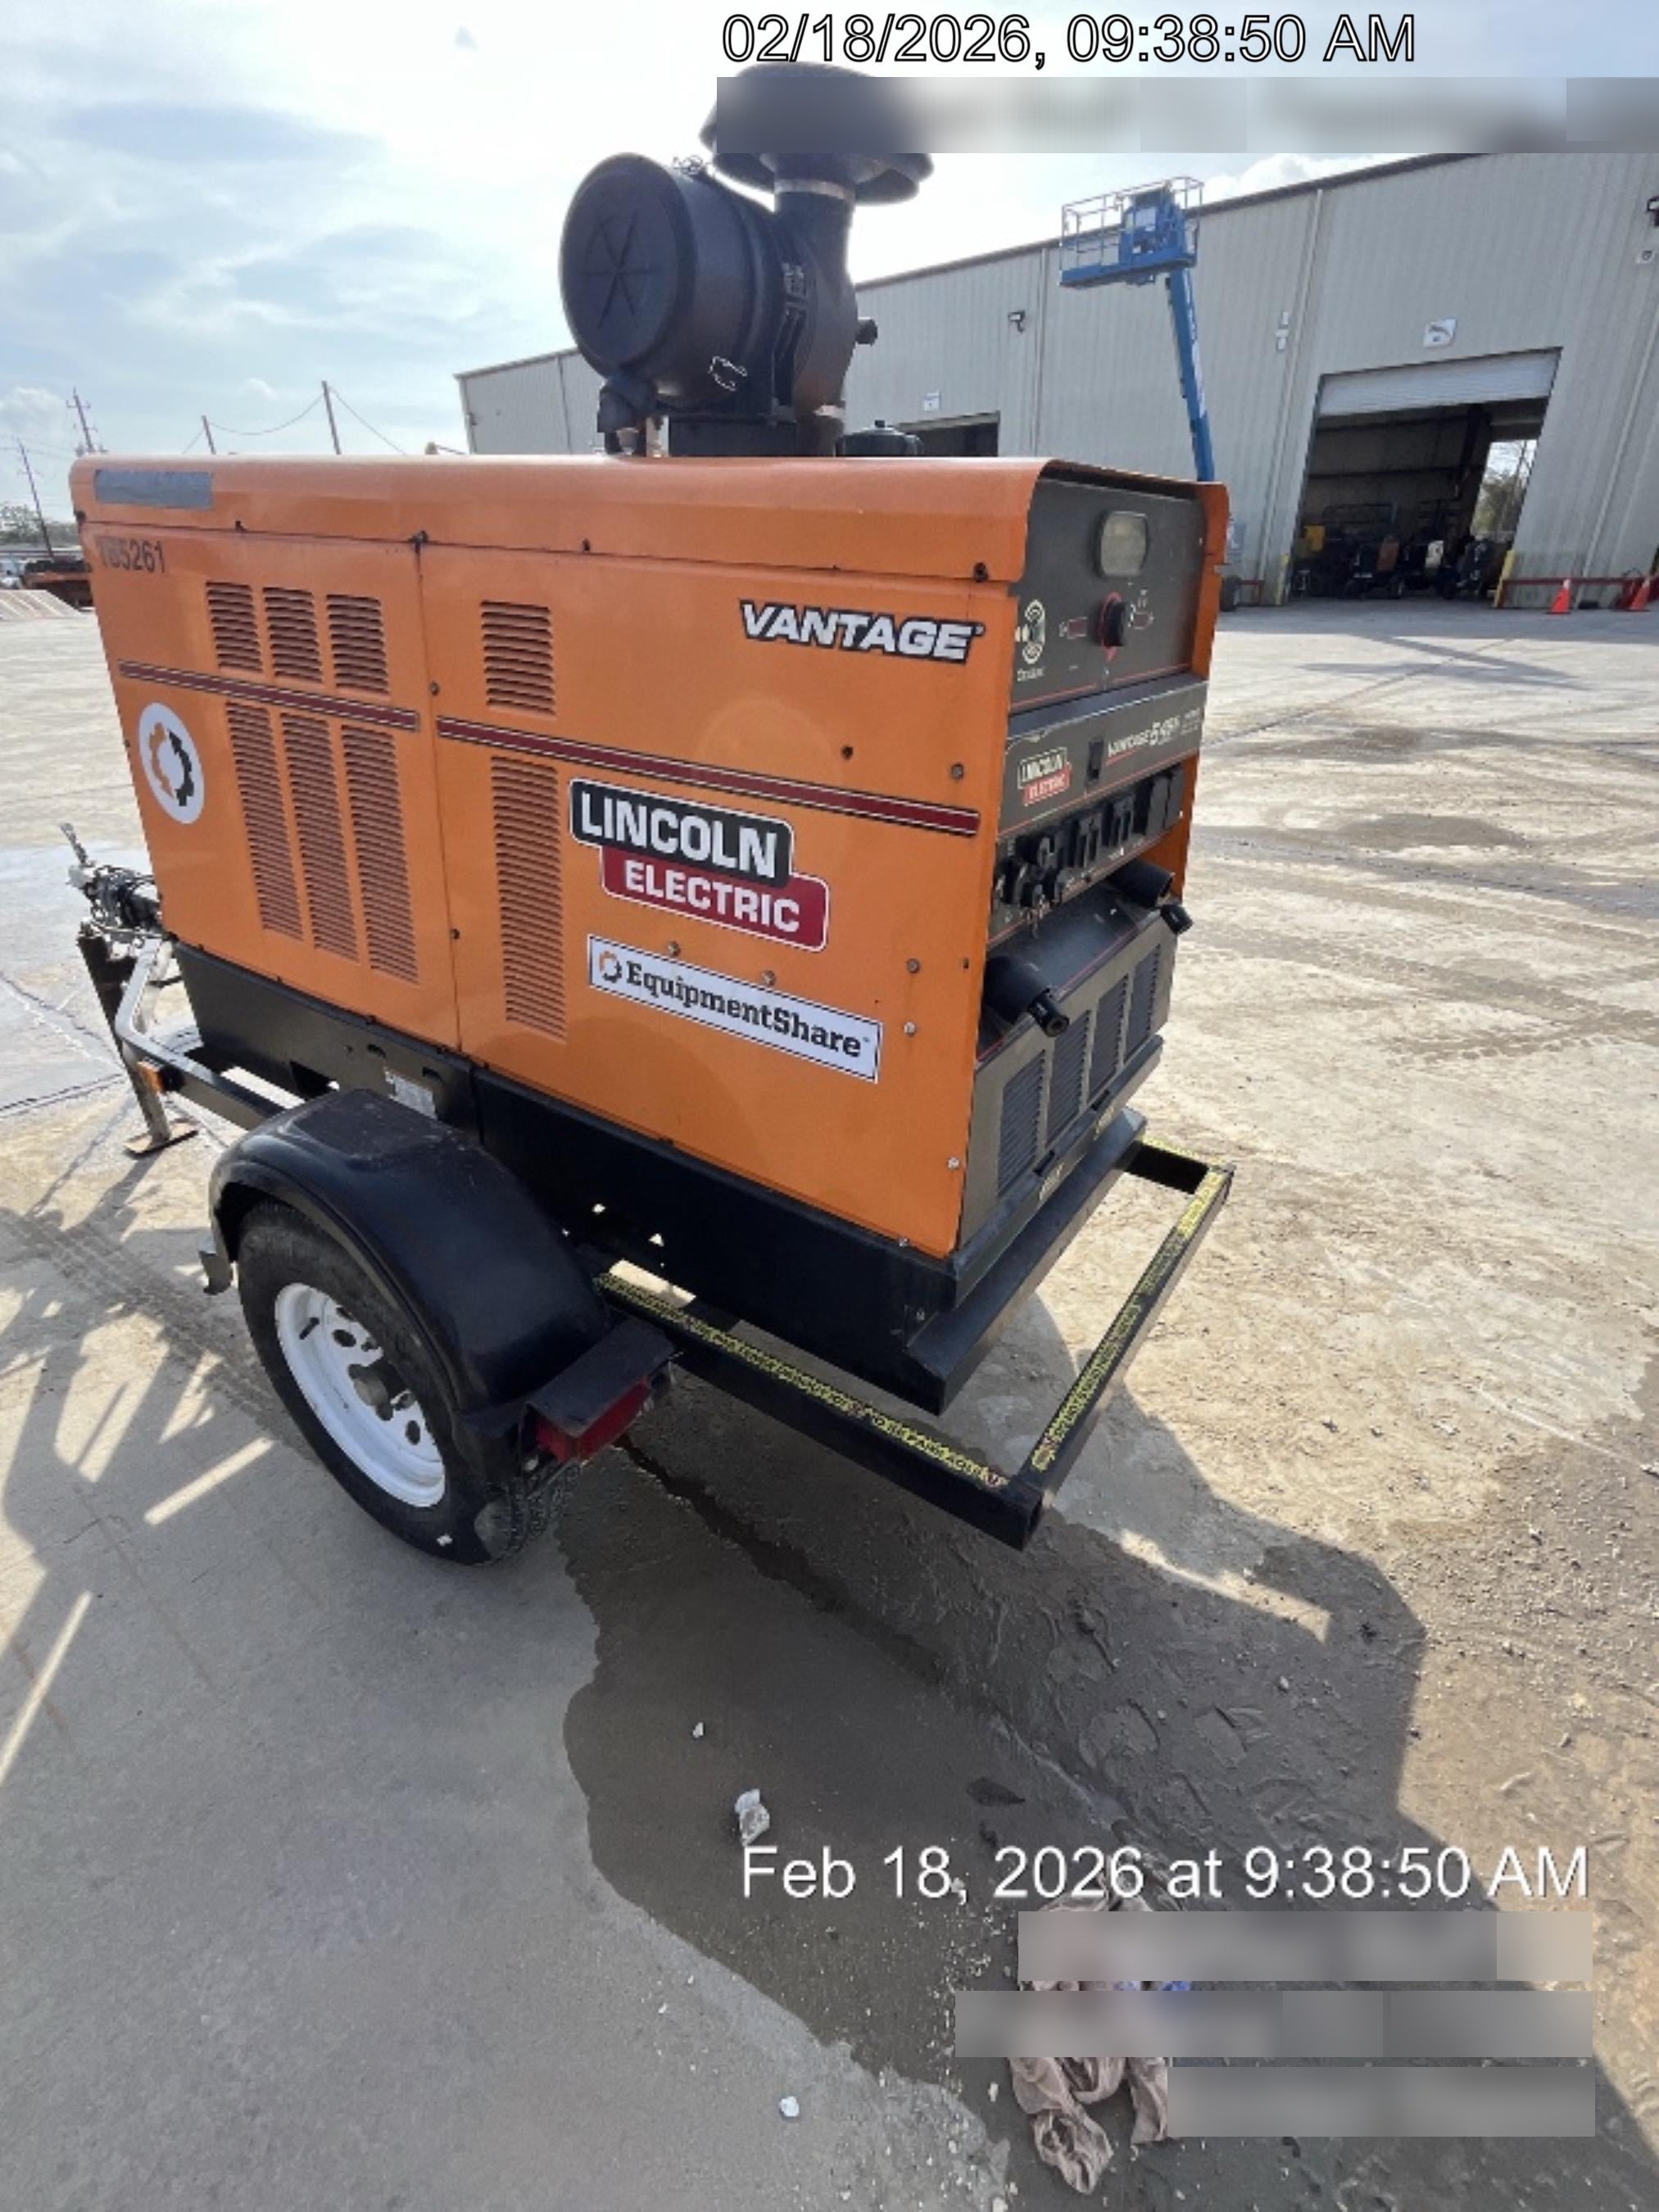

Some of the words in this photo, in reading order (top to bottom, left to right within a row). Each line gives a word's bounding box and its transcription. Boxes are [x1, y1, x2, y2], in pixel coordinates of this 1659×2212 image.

[741, 601, 975, 662] VANTAGE
[581, 791, 777, 879] LINCOLN
[624, 859, 800, 933] ELECTRIC
[625, 959, 862, 1058] EquipmentShare
